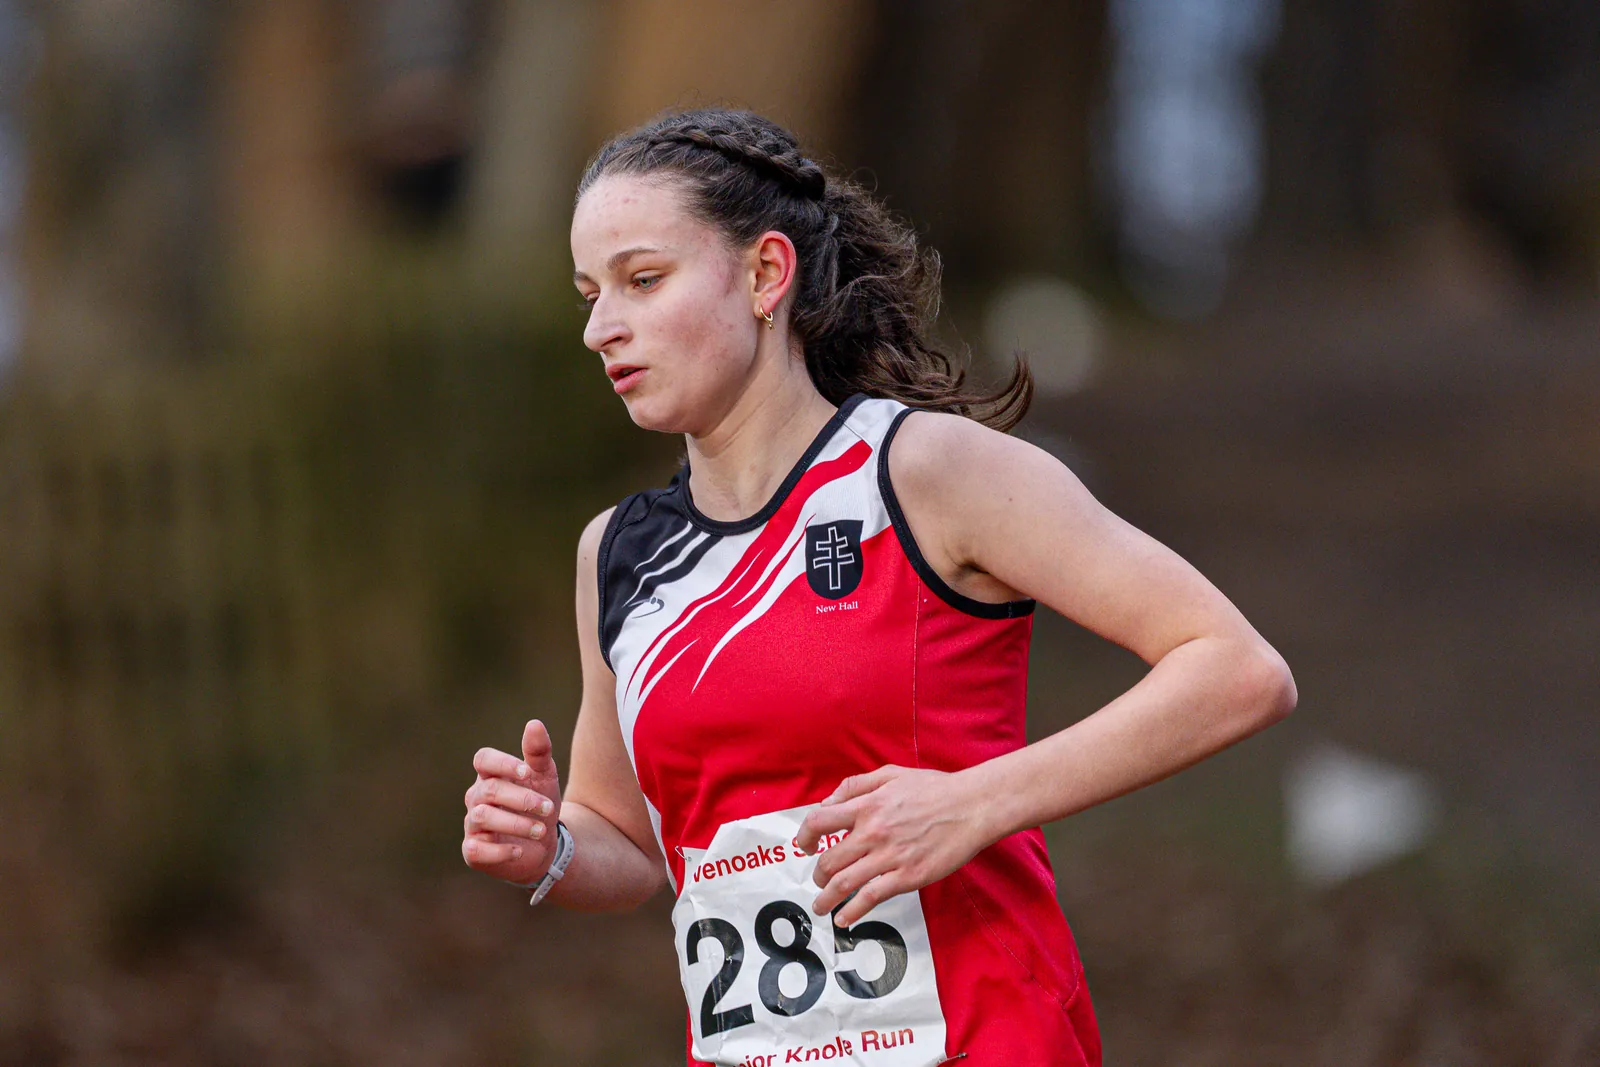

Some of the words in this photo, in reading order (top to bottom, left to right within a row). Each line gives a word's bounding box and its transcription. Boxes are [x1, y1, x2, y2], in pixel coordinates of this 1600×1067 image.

[816, 605, 836, 615] New
[838, 601, 858, 611] Hall
[686, 880, 909, 1038] 285
[731, 1054, 777, 1067] ior
[785, 1036, 853, 1064] Knole
[861, 1028, 914, 1053] Run
